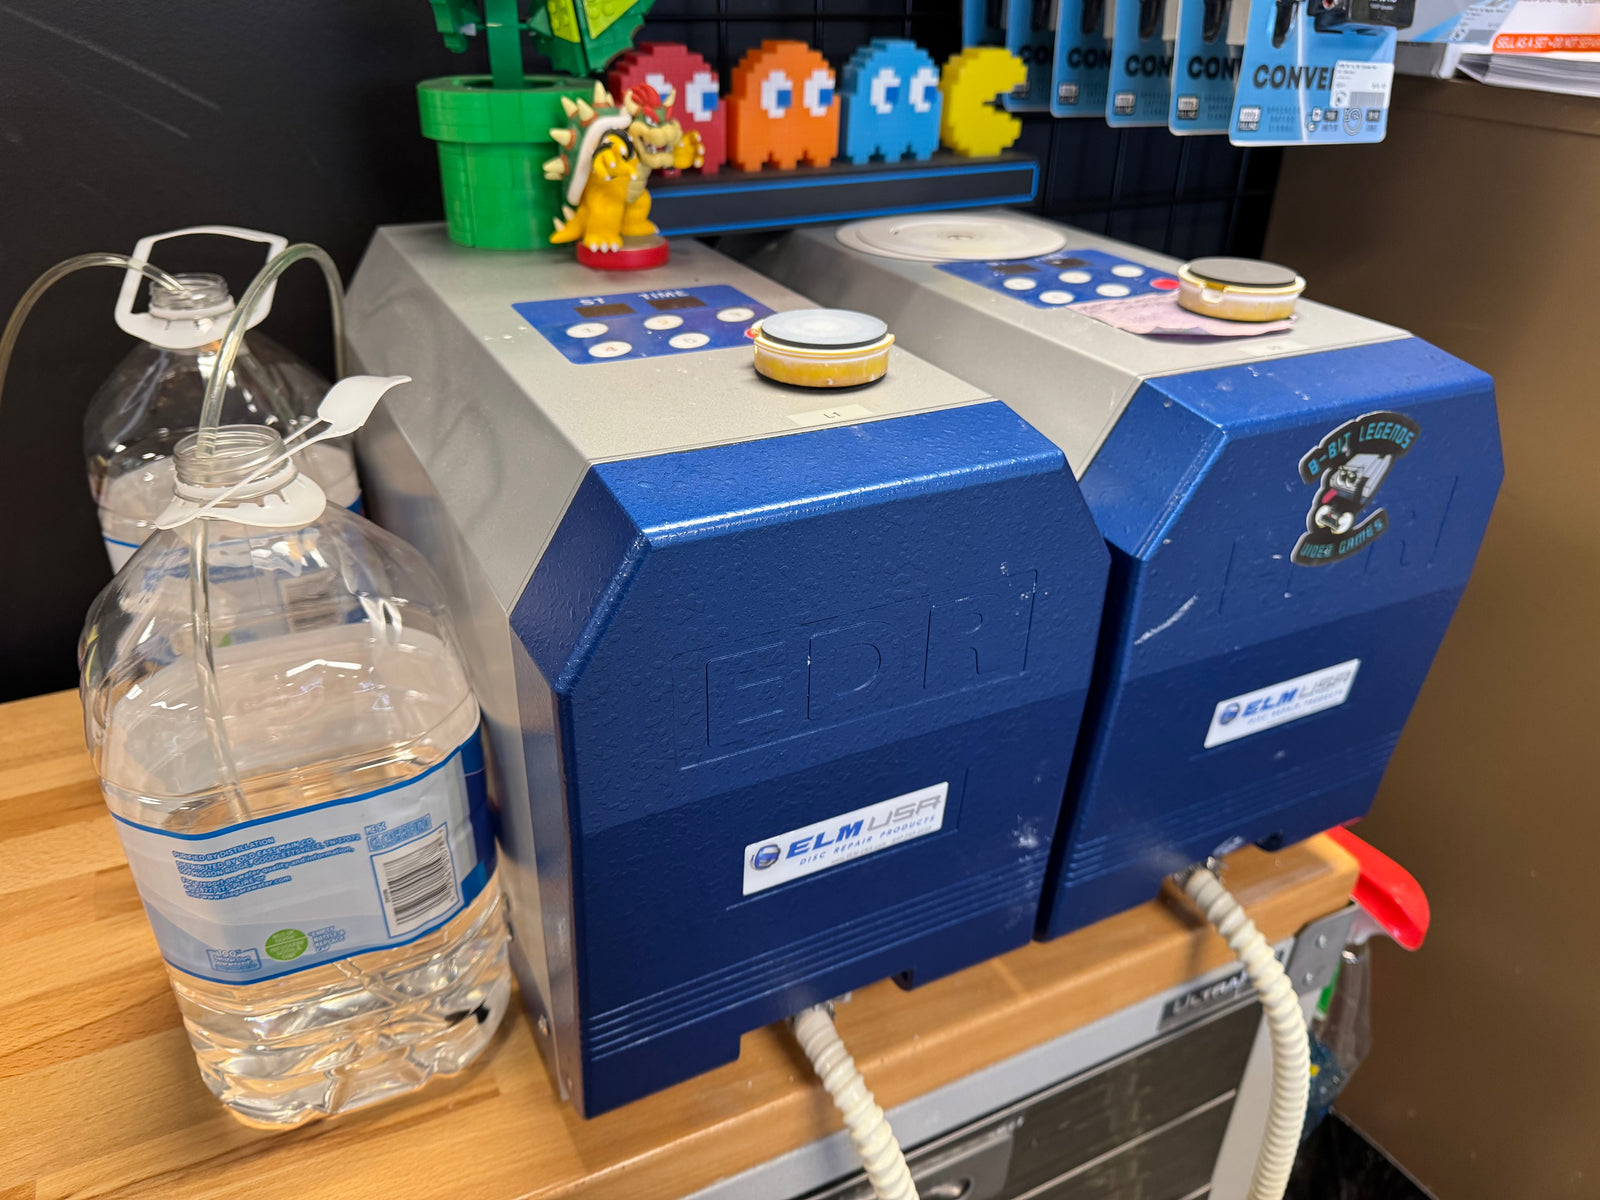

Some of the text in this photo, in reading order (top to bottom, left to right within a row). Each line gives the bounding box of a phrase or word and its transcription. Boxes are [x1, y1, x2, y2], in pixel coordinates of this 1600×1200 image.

[638, 290, 690, 301] TIME
[1359, 421, 1416, 449] LEGENDS
[1338, 518, 1384, 555] GAMES
[1241, 688, 1299, 718] ELM
[786, 819, 864, 860] ELM
[866, 794, 942, 832] USA
[799, 851, 827, 866] DISC
[833, 835, 873, 855] REPAIR
[879, 814, 936, 840] PRODUCTS
[205, 852, 220, 861] BY
[220, 836, 275, 859] DISTILLATION
[224, 857, 237, 867] BY
[238, 852, 255, 863] OLD
[256, 846, 276, 859] EAST
[276, 840, 300, 853] MAIN
[290, 856, 306, 867] and
